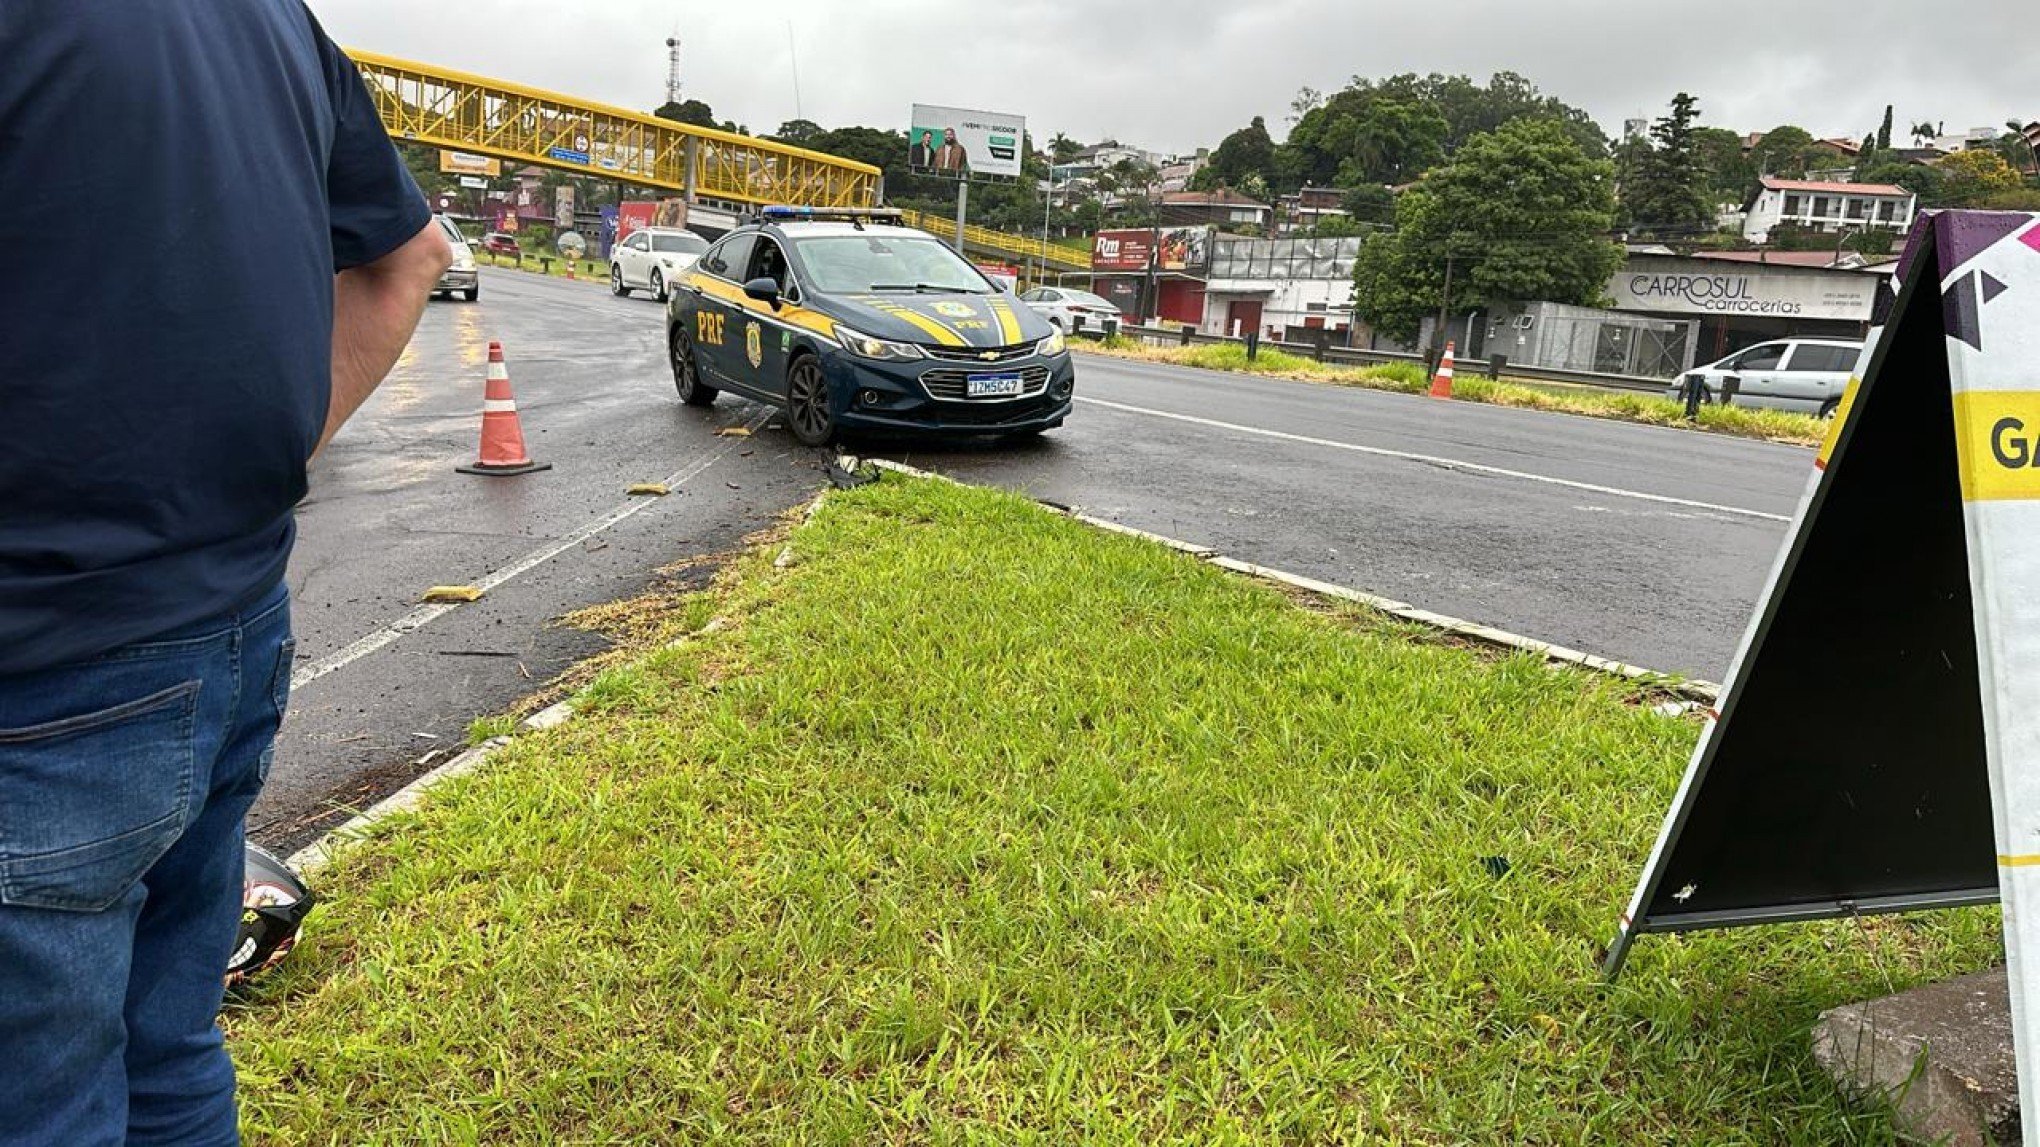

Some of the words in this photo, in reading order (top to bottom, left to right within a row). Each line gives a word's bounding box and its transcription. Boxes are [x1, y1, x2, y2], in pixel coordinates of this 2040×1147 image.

[1096, 236, 1120, 257] Rm
[1630, 275, 1753, 304] CARROSUL
[697, 310, 725, 345] PRF
